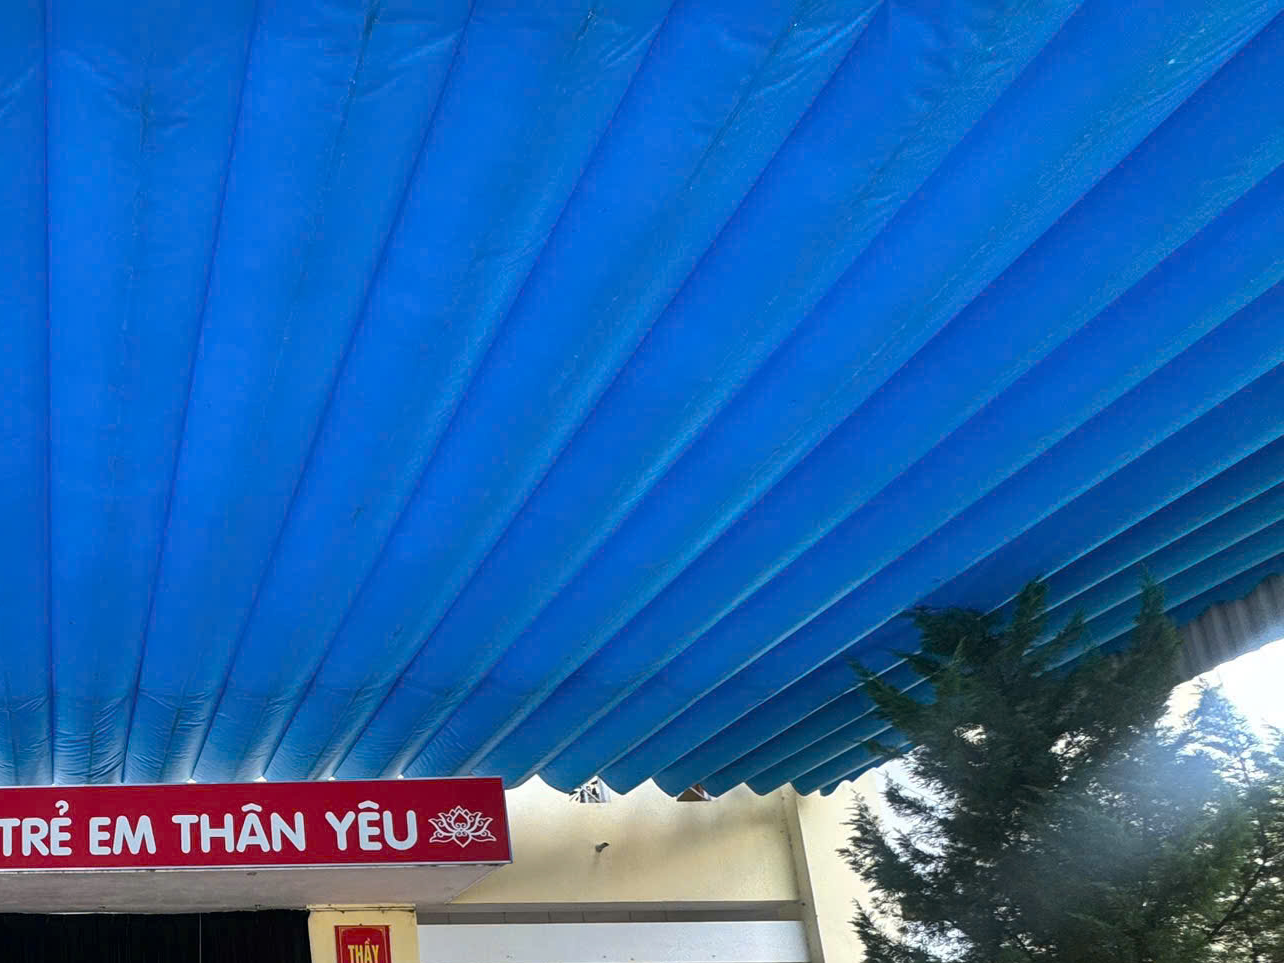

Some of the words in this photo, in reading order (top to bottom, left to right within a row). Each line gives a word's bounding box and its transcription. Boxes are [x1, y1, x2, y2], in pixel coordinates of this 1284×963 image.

[89, 815, 156, 856] EM
[172, 803, 306, 853] THÂN
[325, 800, 417, 851] YÊU
